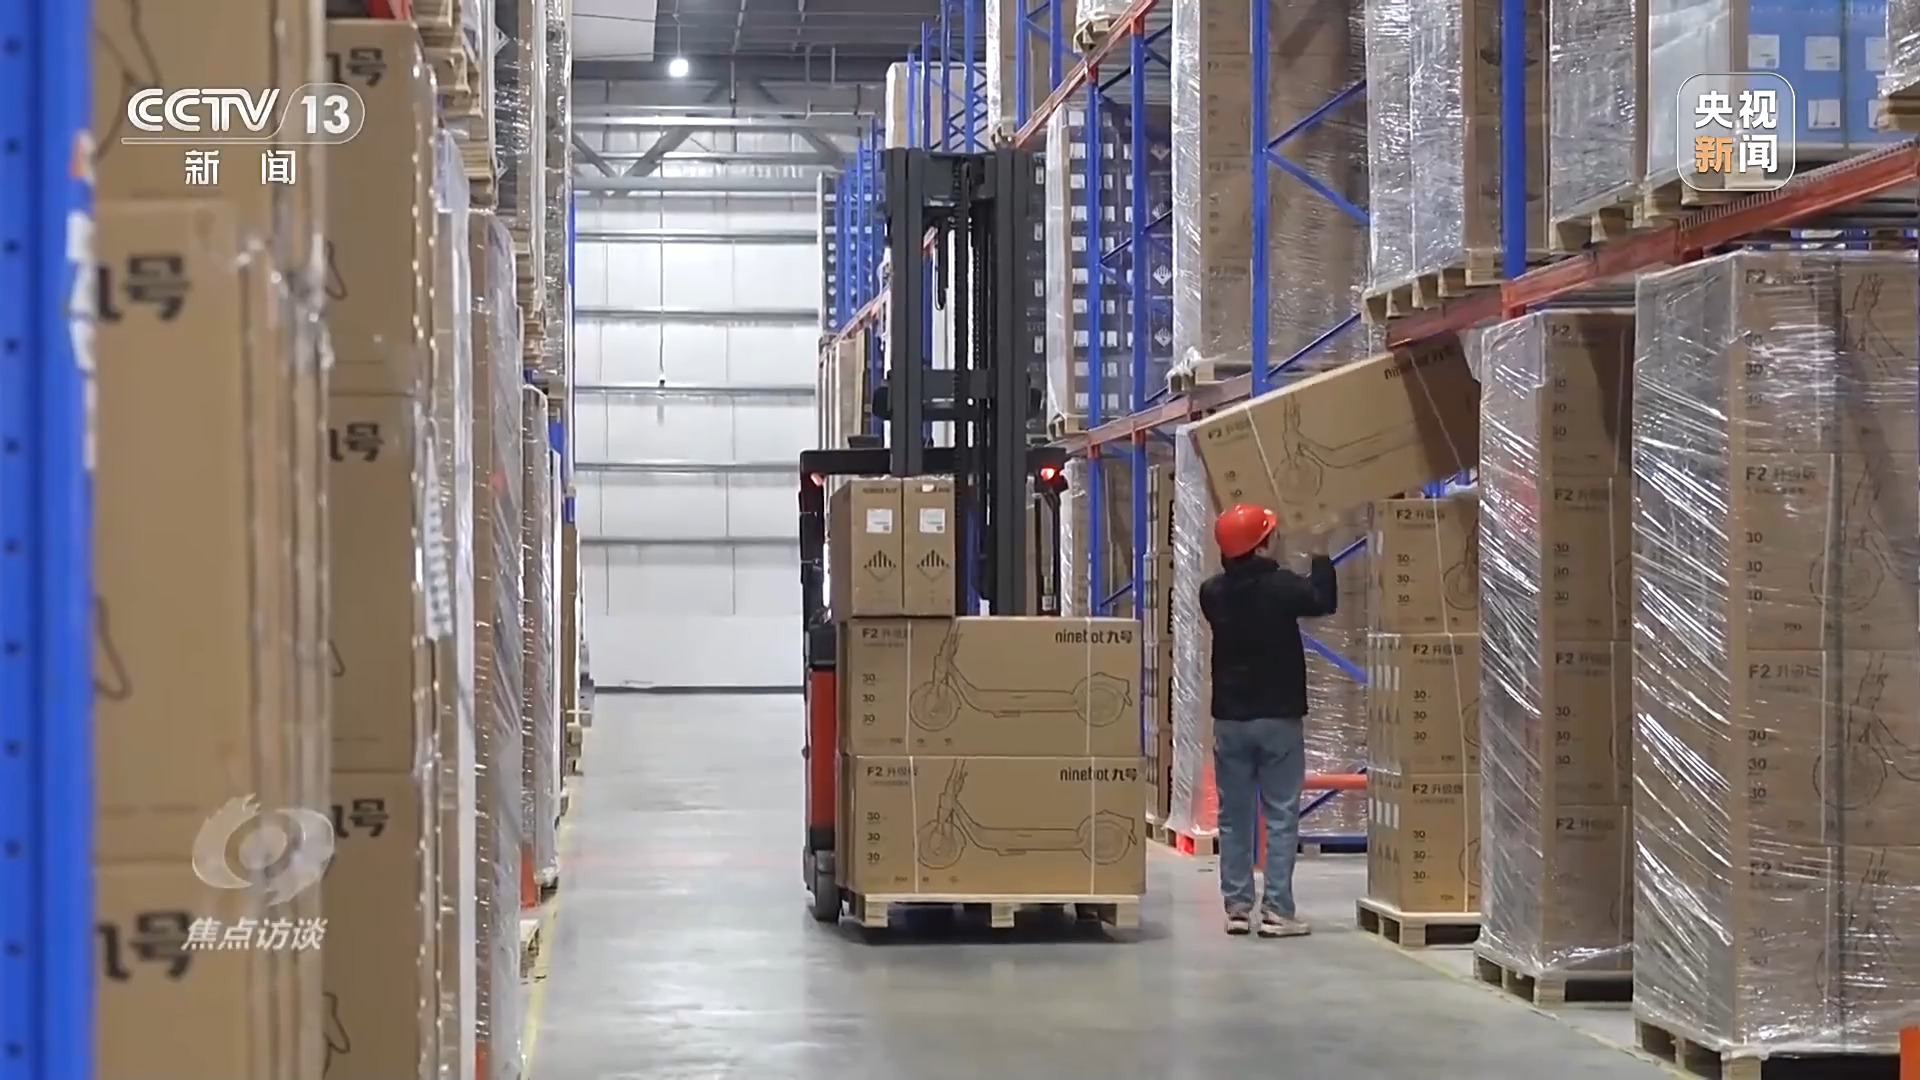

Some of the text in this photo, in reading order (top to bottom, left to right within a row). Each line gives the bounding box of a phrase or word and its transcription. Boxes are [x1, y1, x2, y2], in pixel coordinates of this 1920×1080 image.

[1746, 467, 1766, 481] F2
[1397, 509, 1411, 519] F2
[862, 628, 878, 639] F2
[1413, 644, 1428, 655] F2
[1556, 653, 1573, 664] F2
[1749, 664, 1770, 678] F2
[867, 766, 882, 776] F2
[1412, 784, 1428, 794] F2
[1556, 818, 1574, 830] F2
